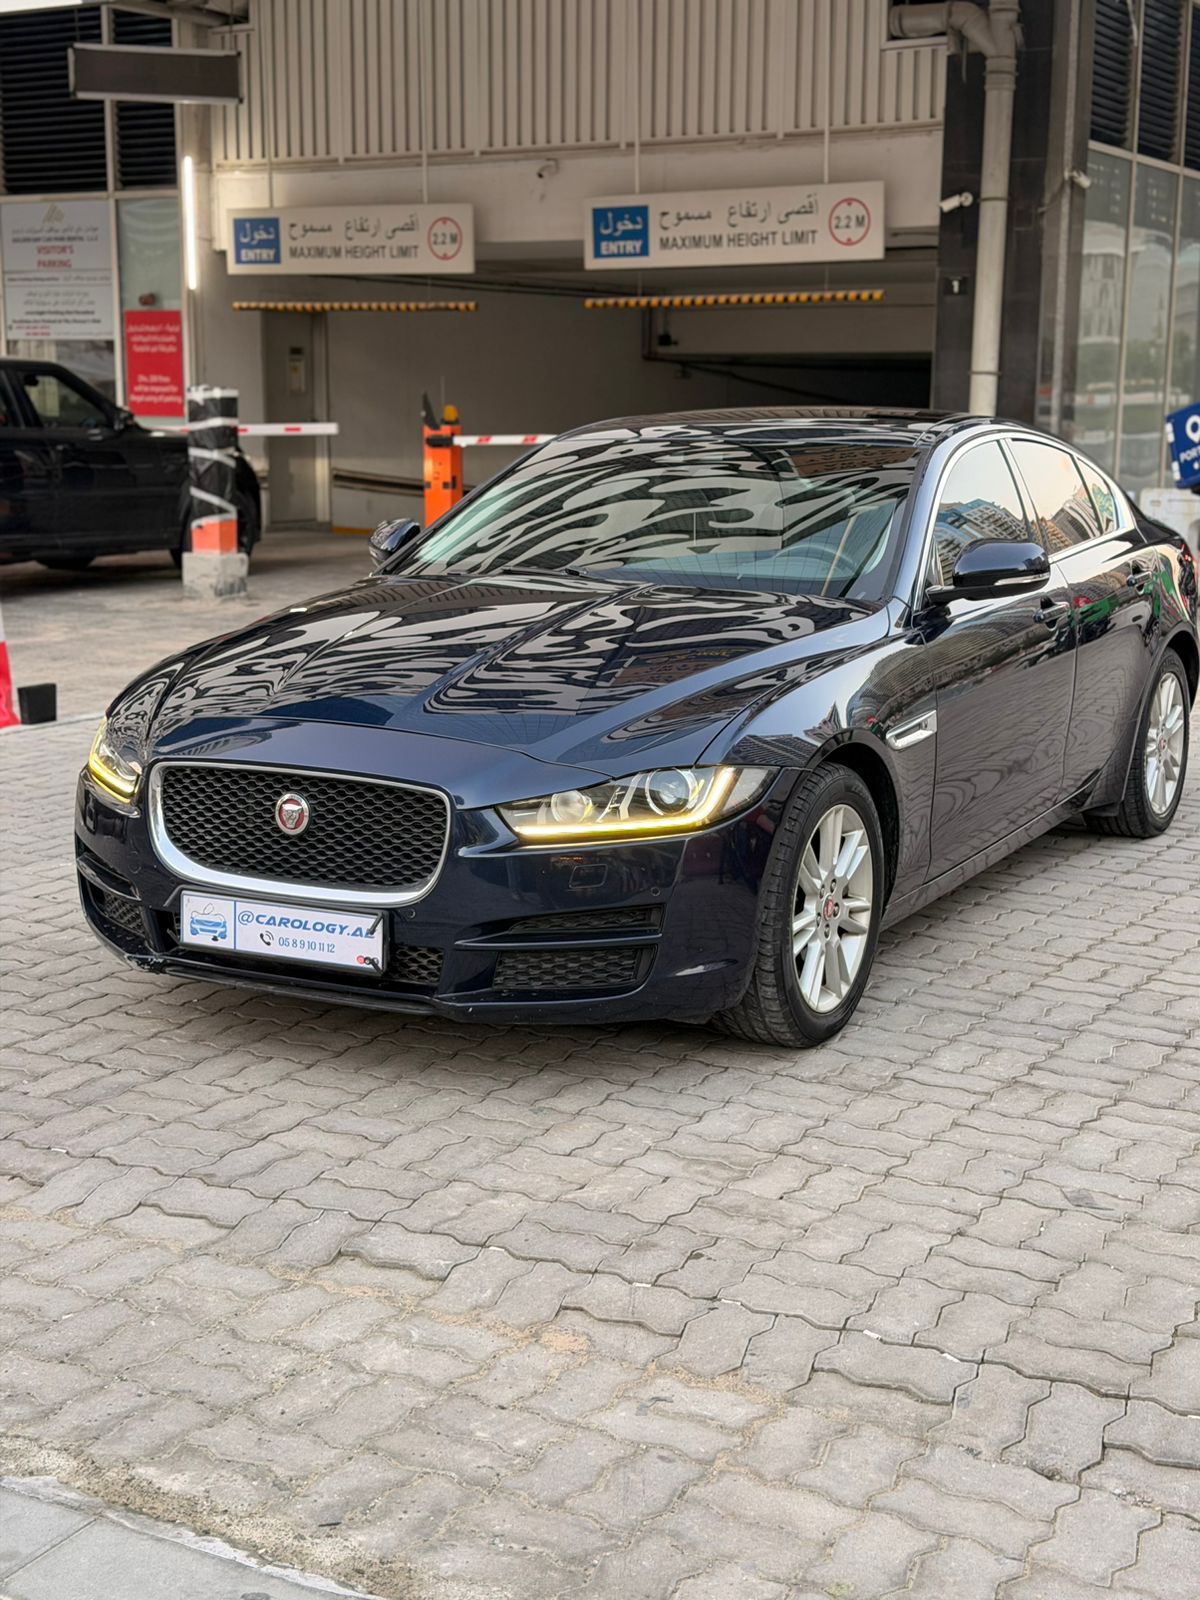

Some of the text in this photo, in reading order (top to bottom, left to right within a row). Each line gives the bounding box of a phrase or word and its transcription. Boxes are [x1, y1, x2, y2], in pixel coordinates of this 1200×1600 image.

[600, 211, 643, 236] دخول
[659, 210, 712, 230] مسموح
[834, 214, 865, 229] 2.2 M
[240, 222, 275, 245] دخول
[289, 223, 332, 241] مسموح
[432, 232, 458, 245] 2.2 M
[659, 229, 818, 250] MAXIMUM HEIGHT LIMIT
[241, 248, 275, 261] ENTRY
[289, 245, 419, 259] MAXIMUM HEIGHT LIMIT
[601, 240, 643, 256] ENTRY
